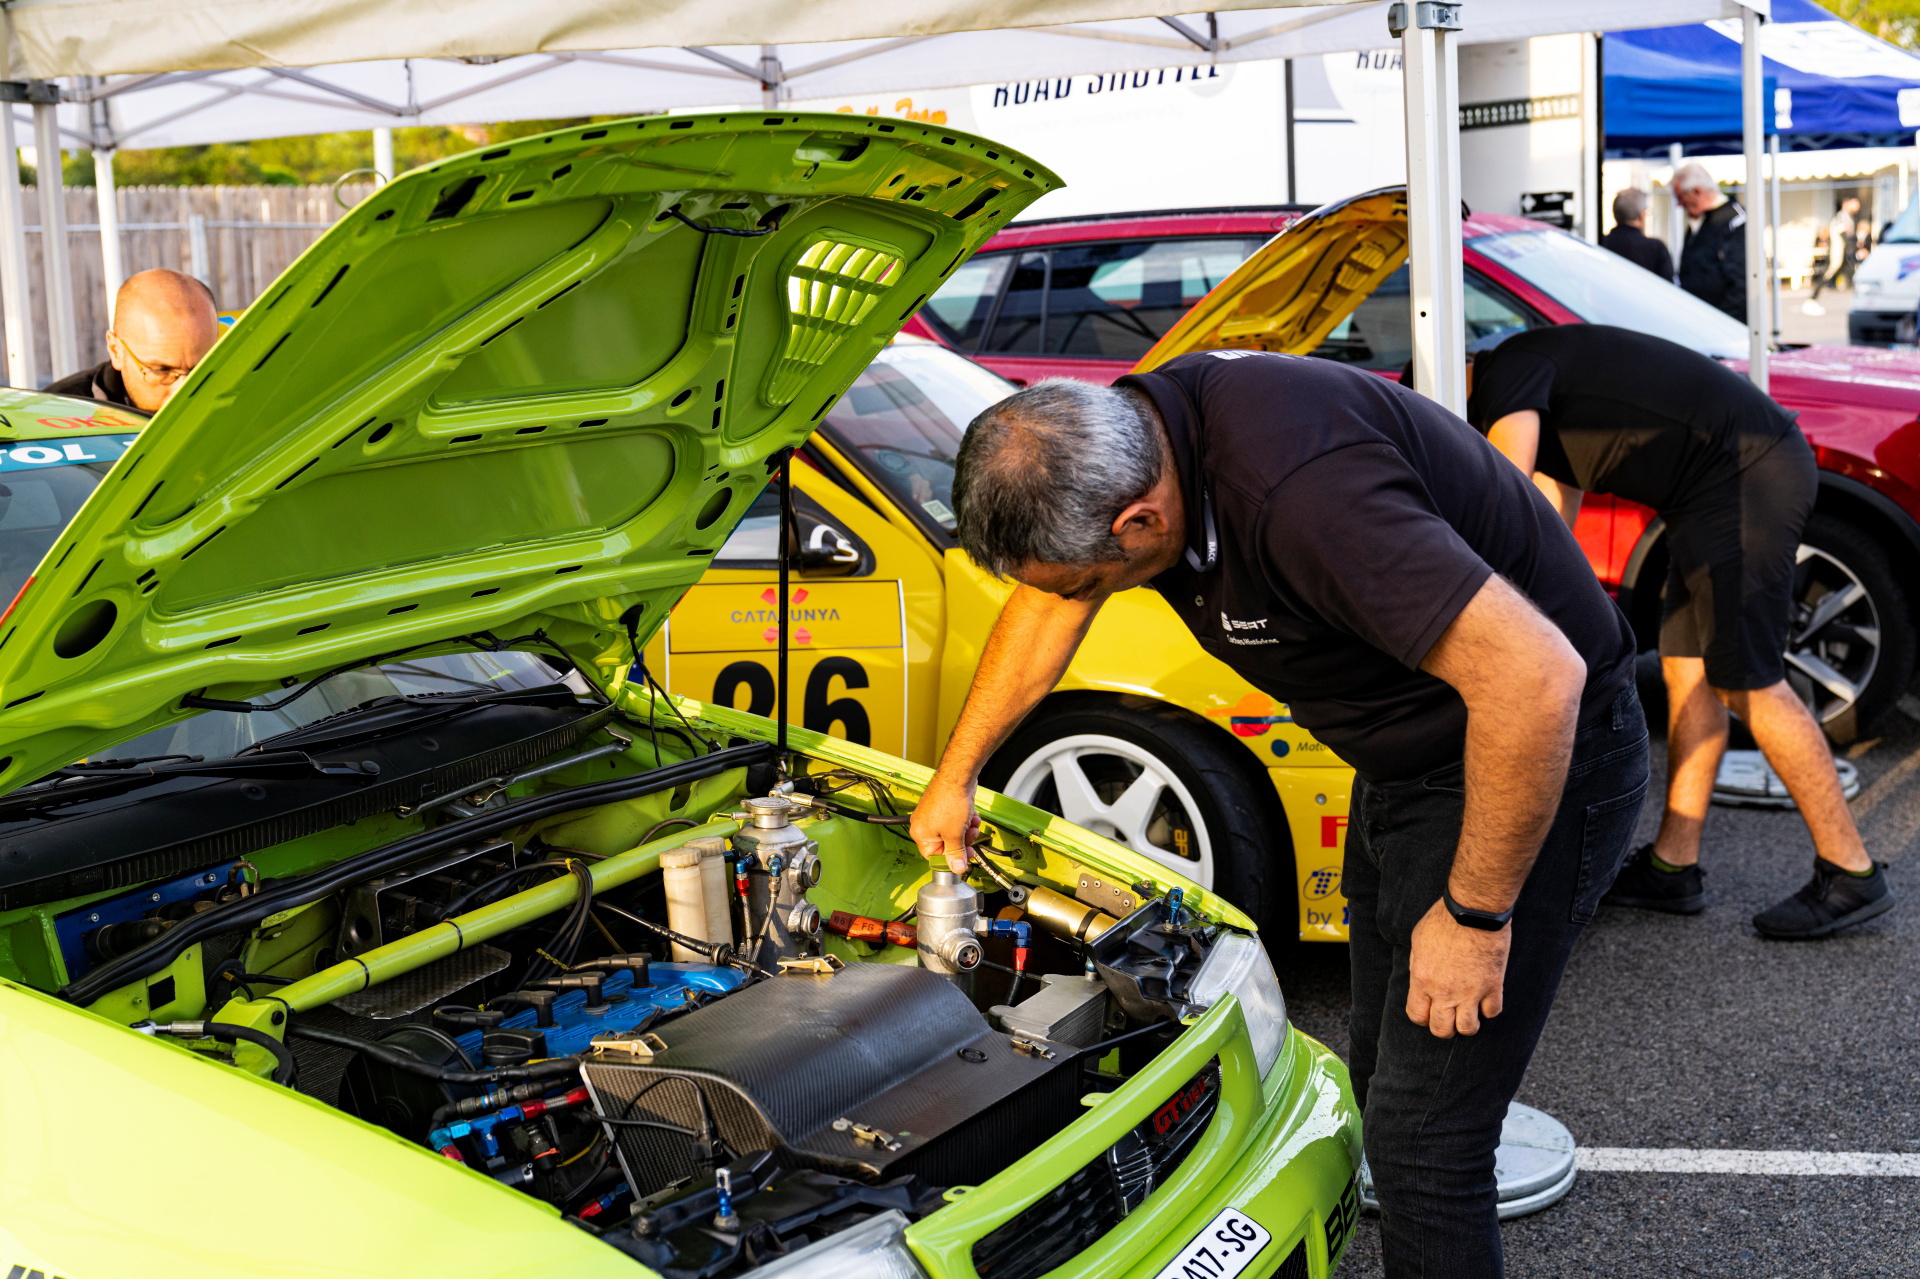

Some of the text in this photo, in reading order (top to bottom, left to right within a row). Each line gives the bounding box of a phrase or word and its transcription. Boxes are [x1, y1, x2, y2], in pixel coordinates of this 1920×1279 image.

[36, 415, 137, 430] OKI
[1207, 541, 1216, 562] RACC
[730, 608, 840, 623] CATAUNYA
[1230, 618, 1268, 630] SEAT
[1296, 742, 1329, 752] Moto
[1307, 908, 1332, 930] by
[1324, 1169, 1361, 1265] BE
[1169, 1218, 1257, 1279] 417-SG
